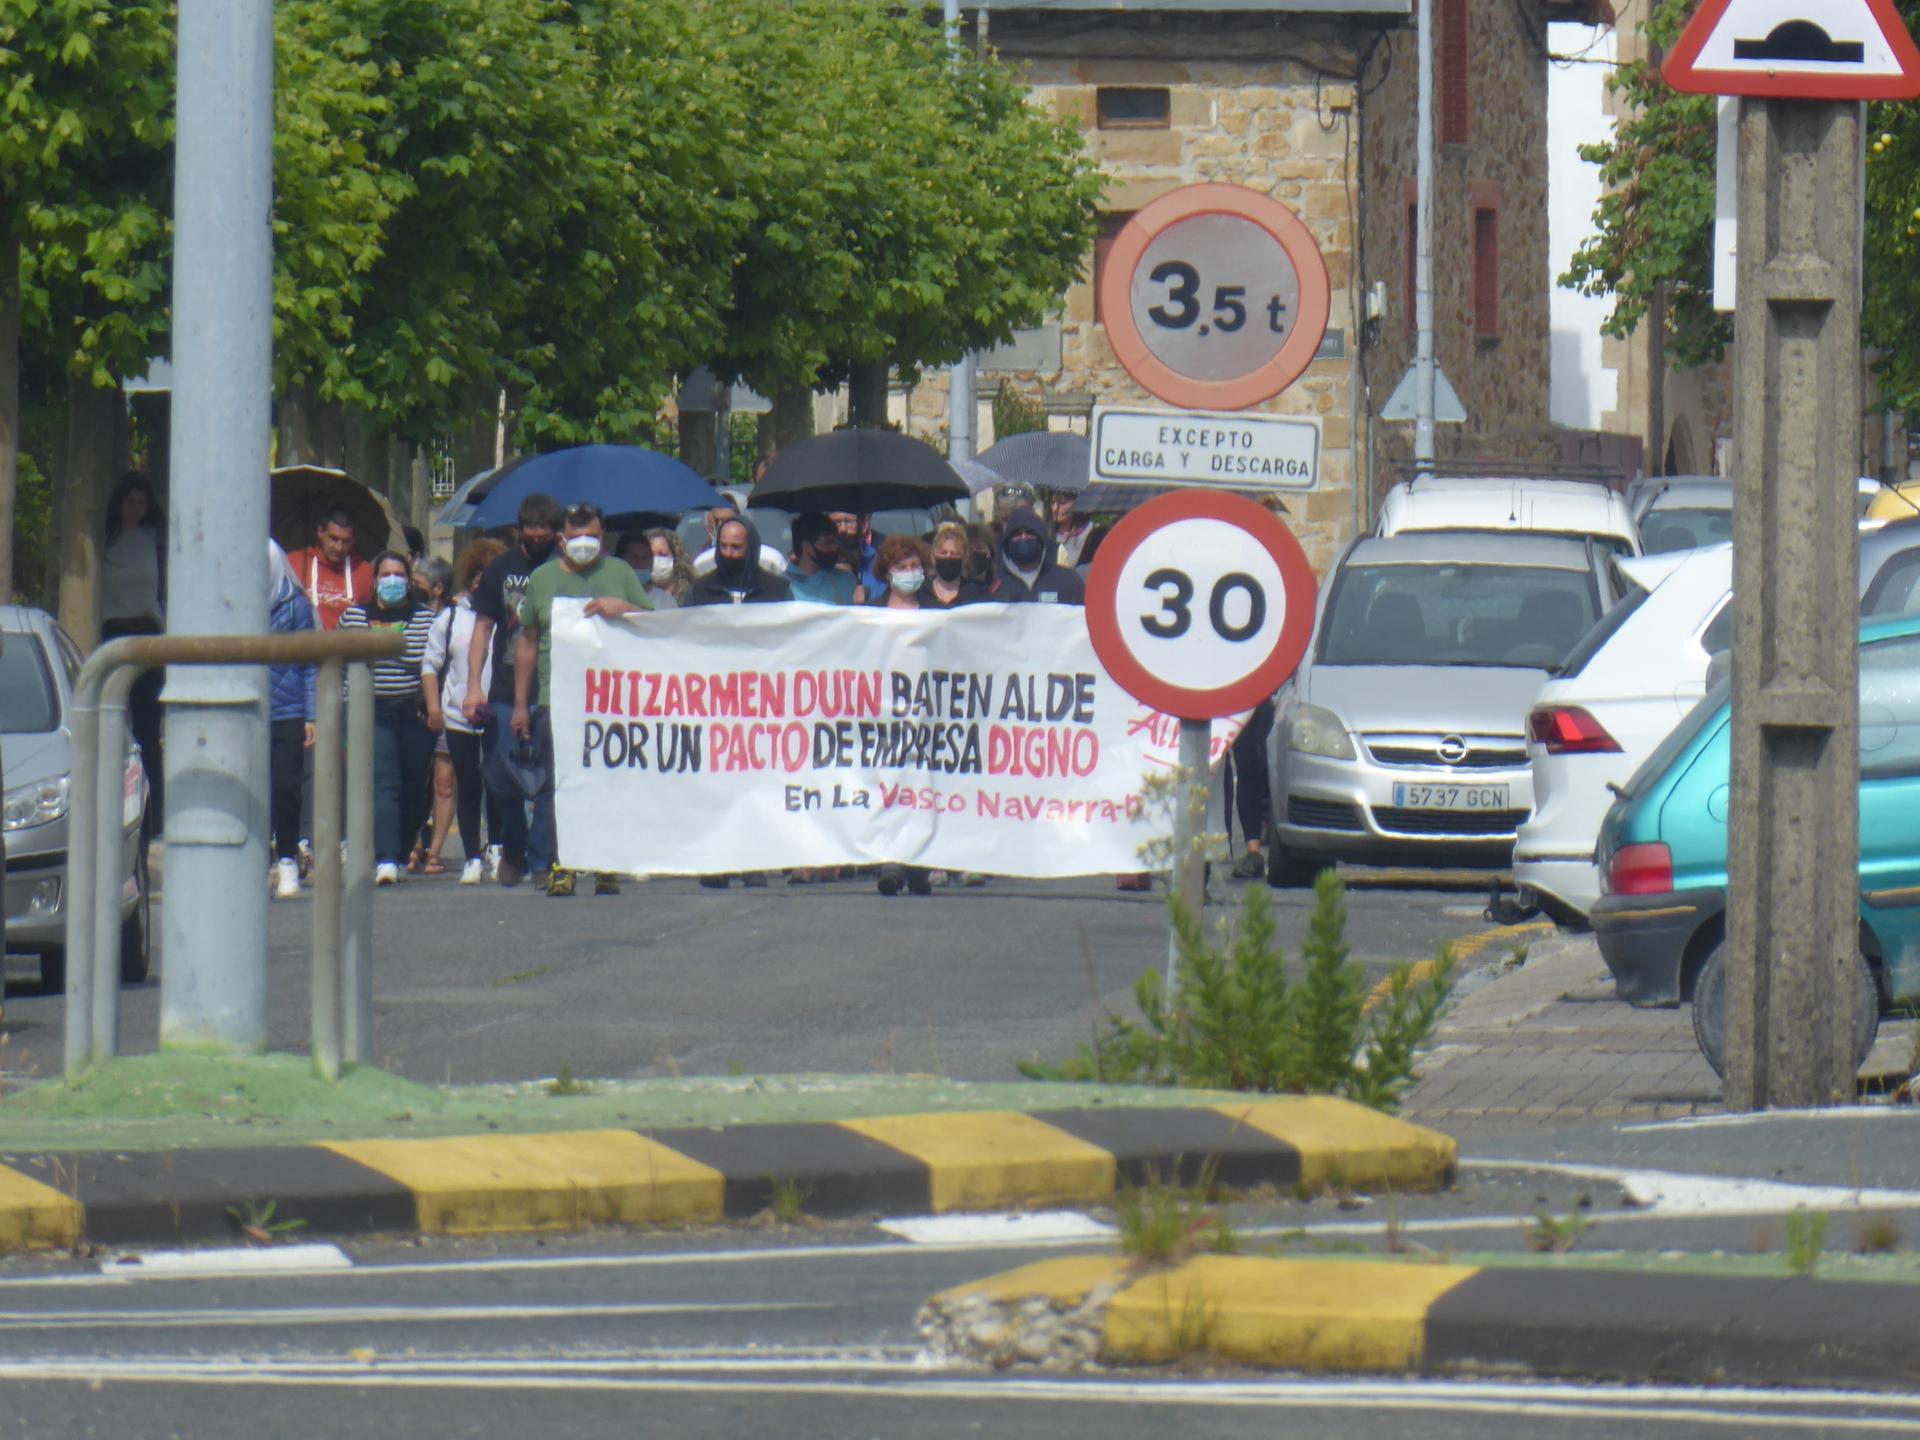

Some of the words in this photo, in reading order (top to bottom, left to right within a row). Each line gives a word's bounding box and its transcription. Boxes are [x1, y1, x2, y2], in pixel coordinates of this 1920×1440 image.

[1266, 294, 1286, 333] t
[1159, 426, 1253, 449] EXCEPTO
[1105, 448, 1165, 469] CARGA
[1180, 452, 1190, 468] Y
[1211, 454, 1309, 477] DESCARGA
[1140, 567, 1266, 643] 30
[585, 667, 786, 718] HITZARMEN
[793, 669, 882, 718] DUIN
[891, 670, 993, 719] BATEN
[999, 672, 1096, 724] ALDE
[583, 719, 649, 769] POR
[656, 721, 702, 773] UN
[709, 720, 810, 773] PACTO
[812, 720, 854, 769] DE
[858, 719, 983, 774] EMPRESA
[988, 723, 1099, 778] DIGNO
[785, 784, 821, 811] En
[833, 784, 870, 808] La
[879, 781, 967, 813] Vasco
[1410, 787, 1459, 806] 5737
[1467, 789, 1502, 807] GCN
